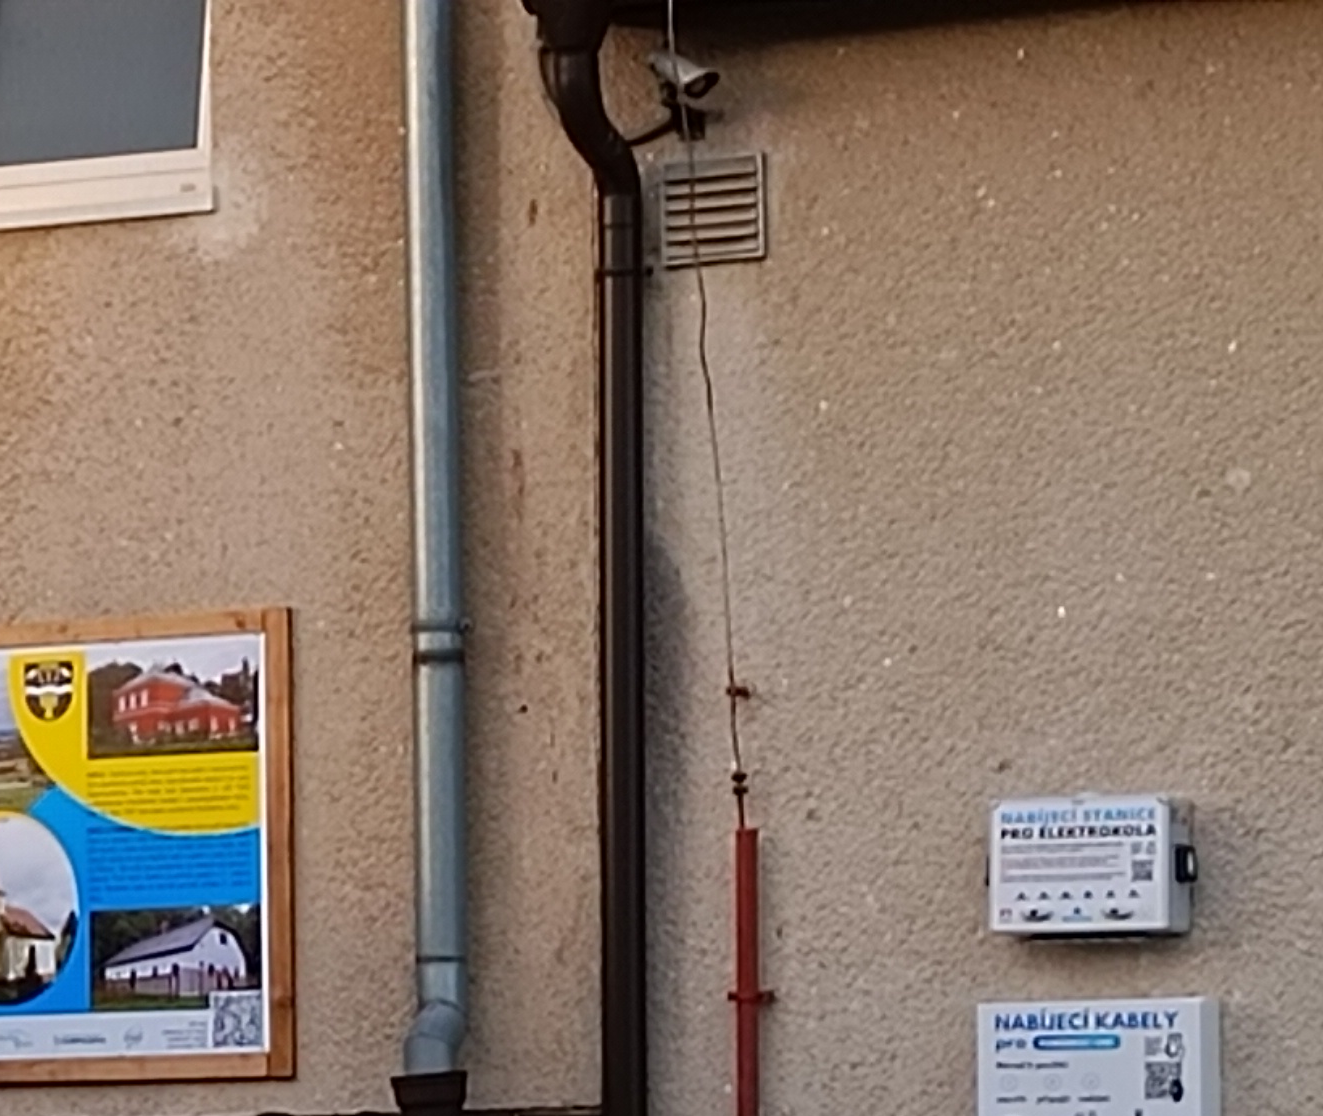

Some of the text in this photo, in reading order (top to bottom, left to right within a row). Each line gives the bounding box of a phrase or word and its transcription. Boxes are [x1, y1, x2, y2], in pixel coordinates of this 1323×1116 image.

[1083, 806, 1155, 822] STANICE
[1000, 822, 1157, 840] PRO ELEKTROKOLA
[994, 1007, 1179, 1031] NABÍJECÍ KABELY
[995, 1037, 1028, 1054] pro
